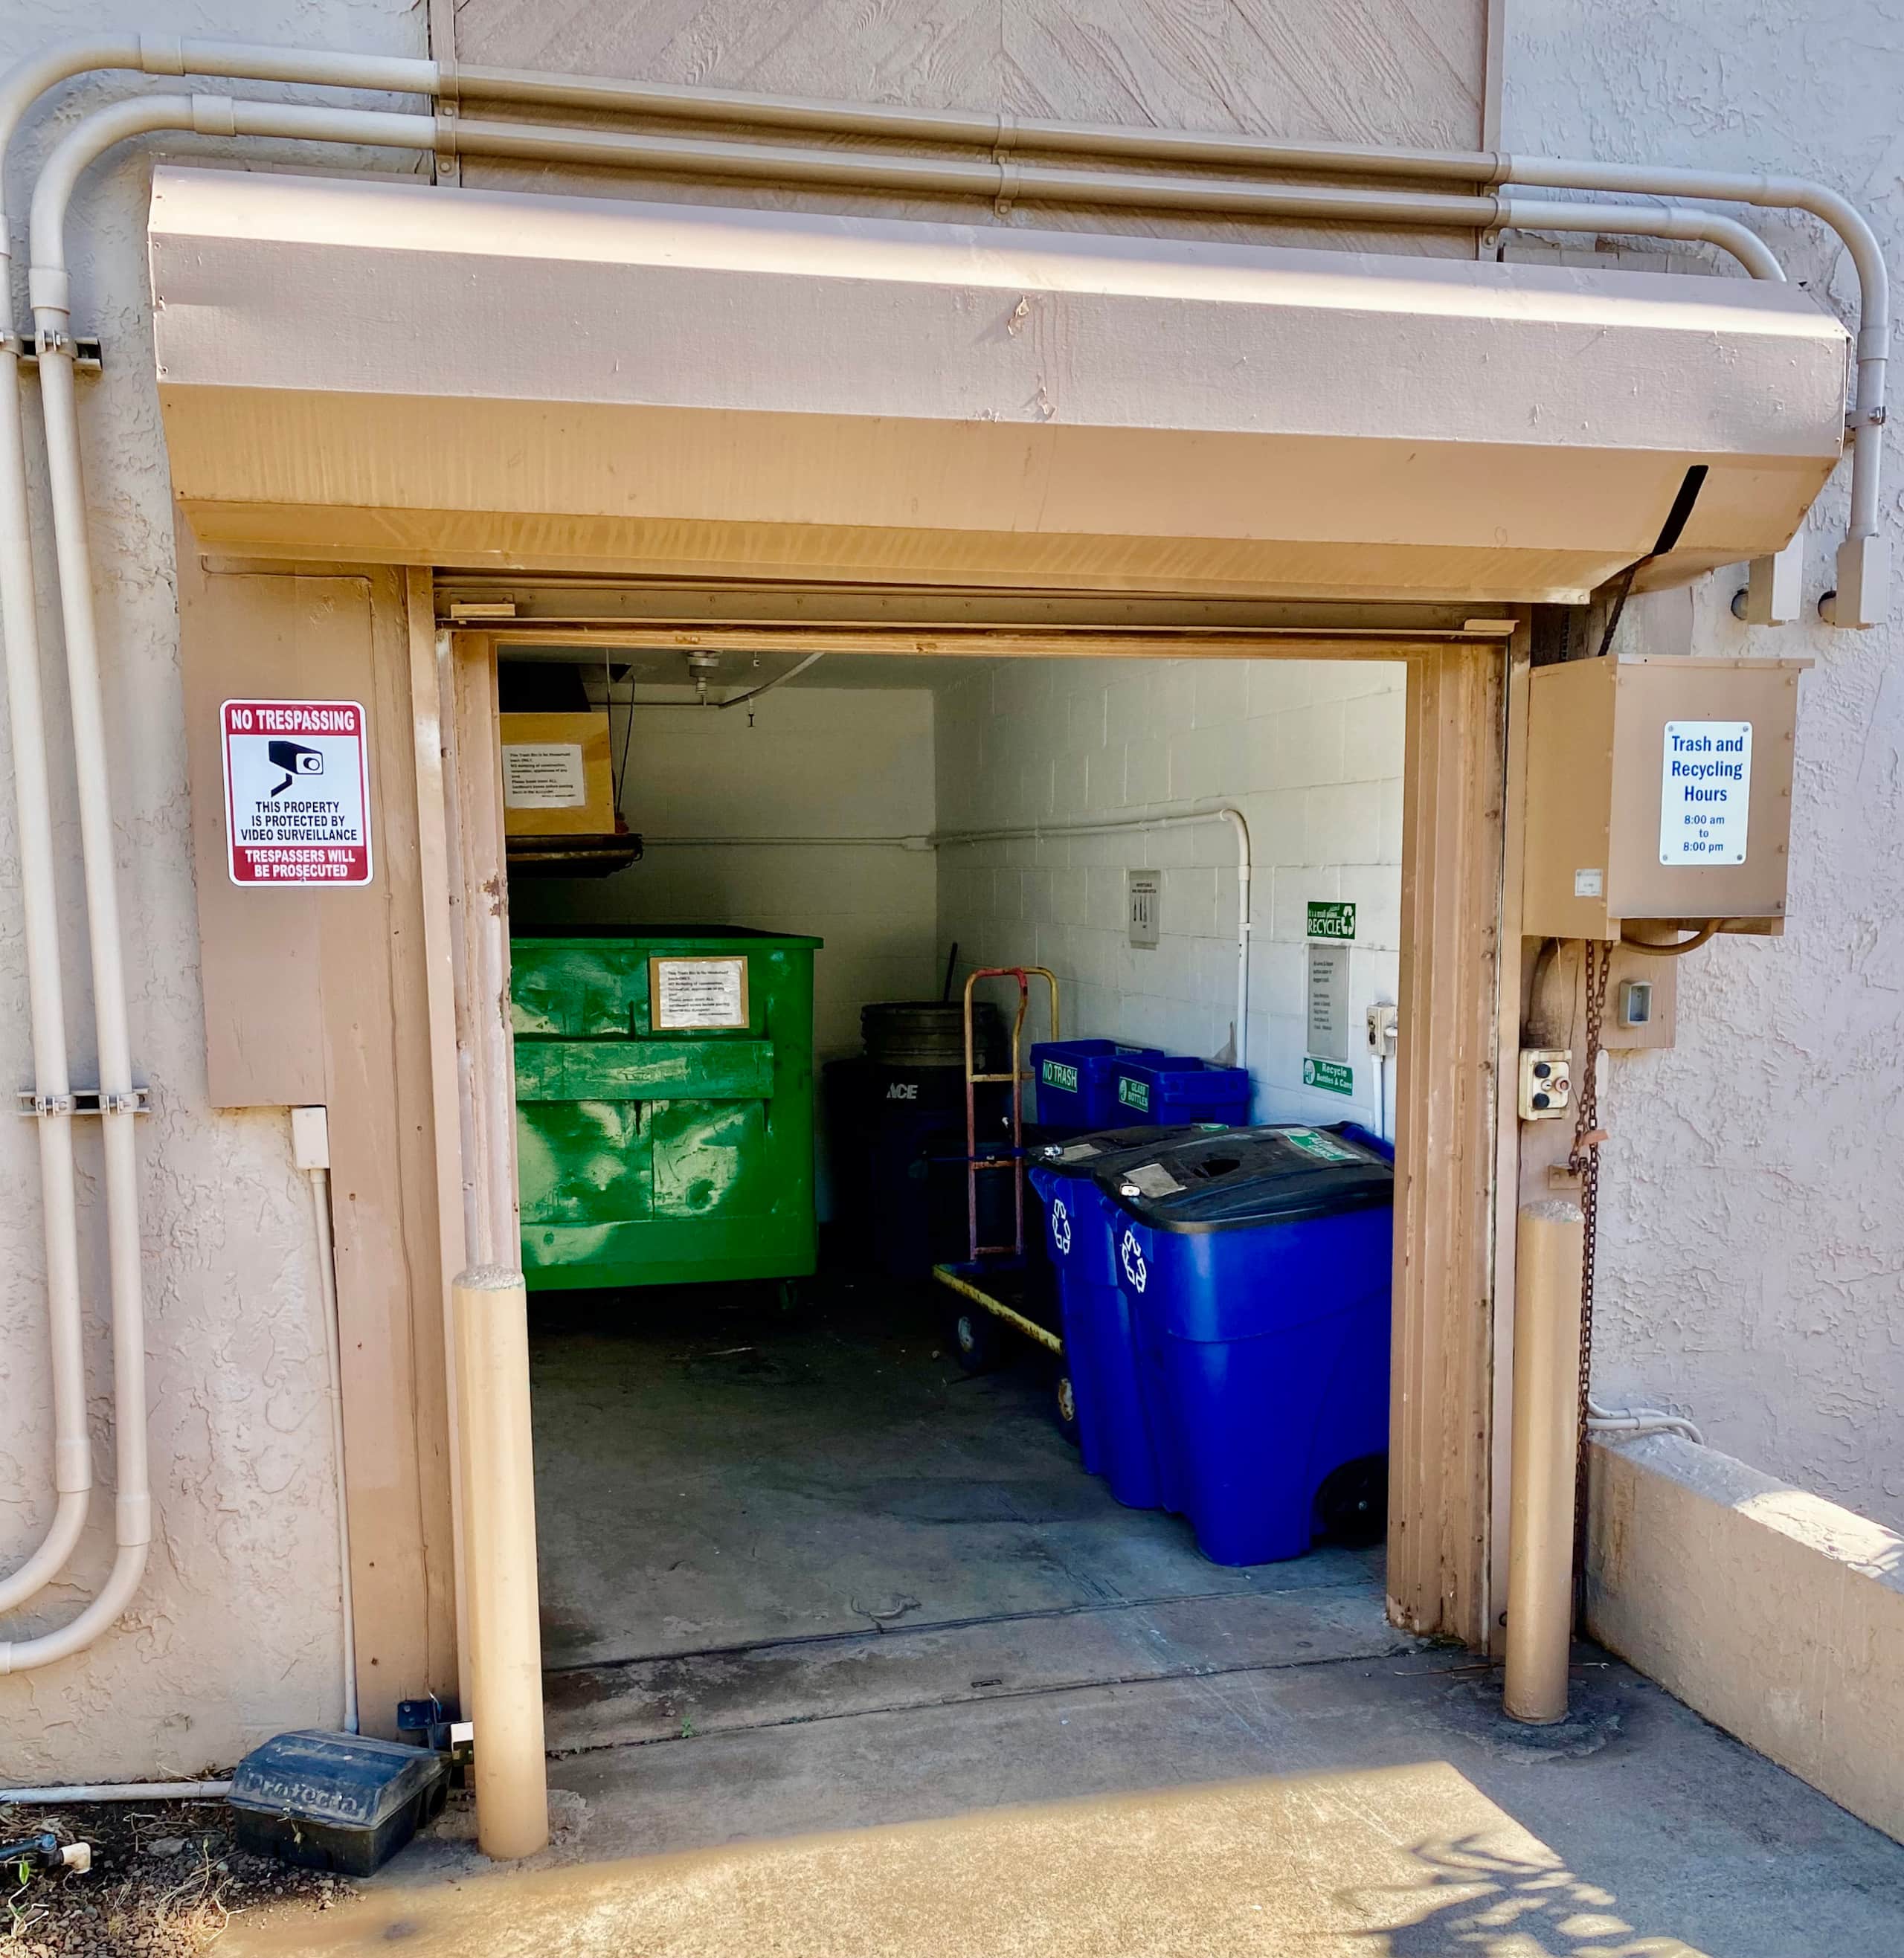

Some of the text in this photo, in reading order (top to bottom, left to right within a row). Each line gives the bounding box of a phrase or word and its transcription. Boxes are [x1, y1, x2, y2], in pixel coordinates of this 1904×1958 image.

[231, 709, 355, 731] NO TRESPASSING
[1672, 735, 1743, 752] Trash and
[1672, 761, 1743, 780] Recycling
[1685, 785, 1727, 802] Hours
[256, 801, 339, 813] THIS PROPERTY
[252, 815, 345, 826] IS PROTECTED BY
[1684, 815, 1725, 825] 8:00 am
[241, 829, 357, 840] VIDEO SURVEILLANCE
[1699, 828, 1709, 838] to
[1683, 842, 1723, 853] 8:00 pm
[245, 849, 356, 863] TRESPASSERS WILL
[254, 864, 348, 877] BE PROSECUTED
[1308, 918, 1341, 935] RECYCLE
[1043, 1062, 1077, 1088] NO TRASH
[1322, 1063, 1348, 1078] Recycle
[887, 1082, 919, 1099] ACE
[1130, 1082, 1146, 1095] GLASS
[1128, 1091, 1148, 1107] BOTTLES
